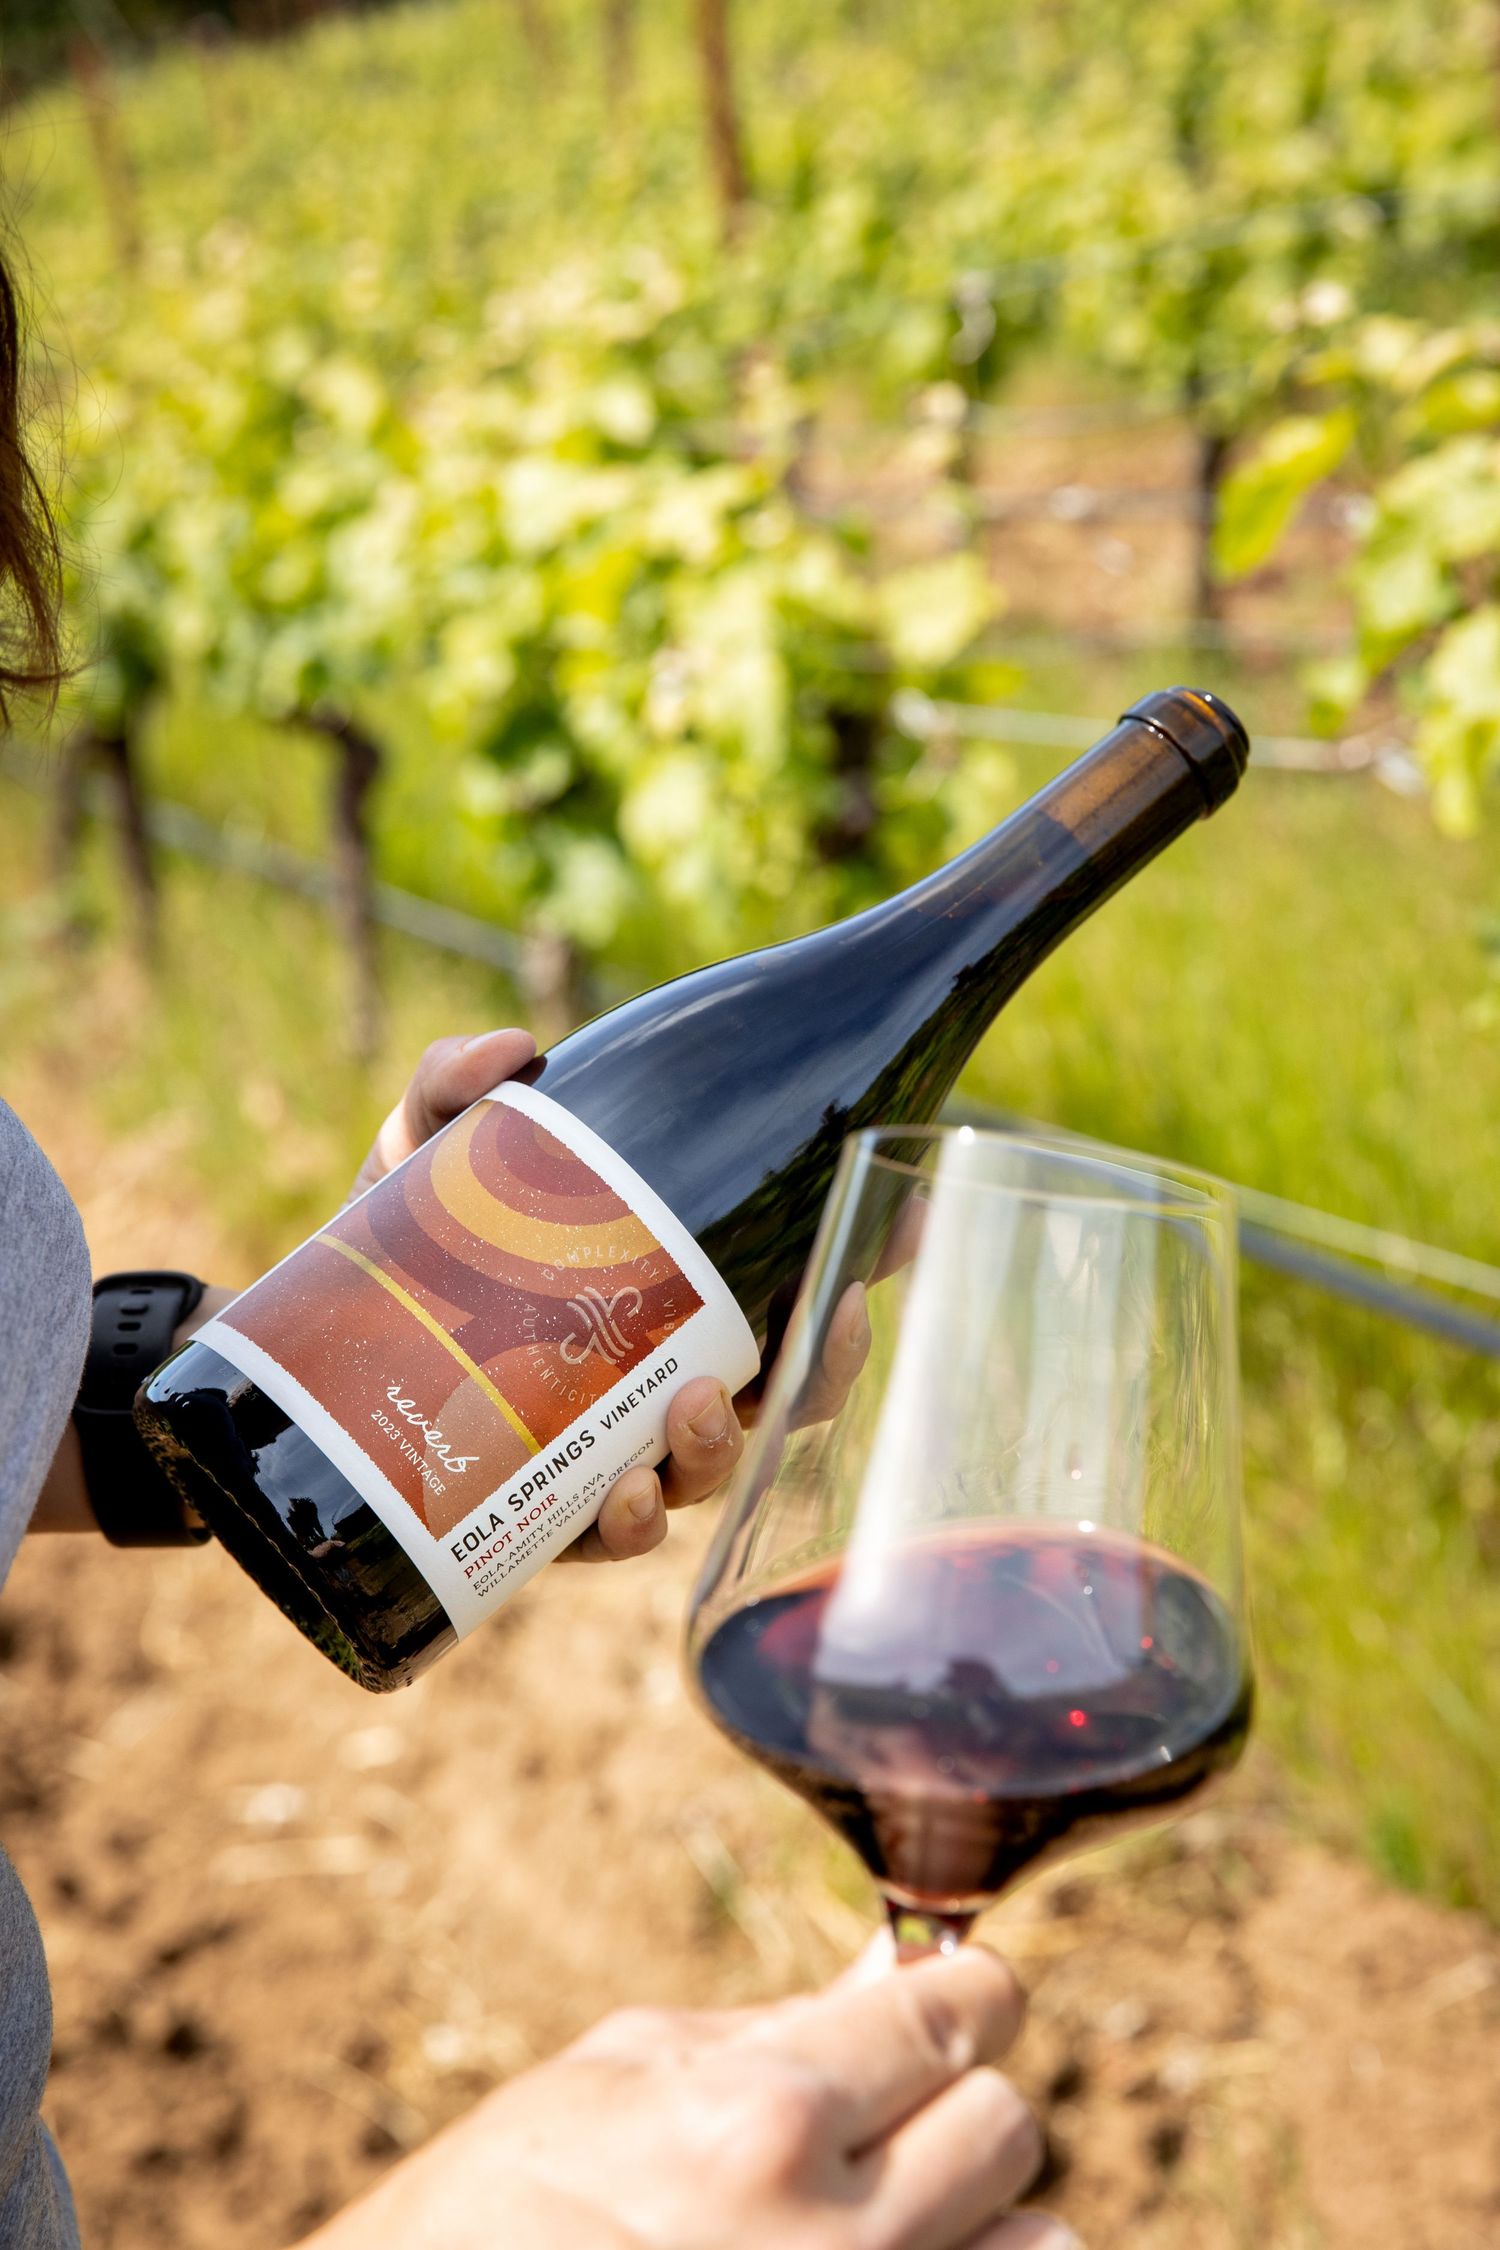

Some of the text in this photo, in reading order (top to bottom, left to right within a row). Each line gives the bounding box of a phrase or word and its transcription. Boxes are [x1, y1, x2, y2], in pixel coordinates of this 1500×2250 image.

[541, 1246, 660, 1281] COMPLEXITY
[523, 1303, 600, 1405] AUTHENTICIT
[660, 1299, 676, 1342] VIB
[370, 1409, 447, 1496] 2023 VINTAGE
[386, 1386, 480, 1473] reverb
[450, 1357, 679, 1563] EOLA SPRINGS VINEYARD
[463, 1493, 559, 1579] PINOT NOIR
[472, 1471, 606, 1591] EOLA-AMITY HILLS AVA
[477, 1437, 655, 1598] WILLAMETTE VALLEY OREGON
